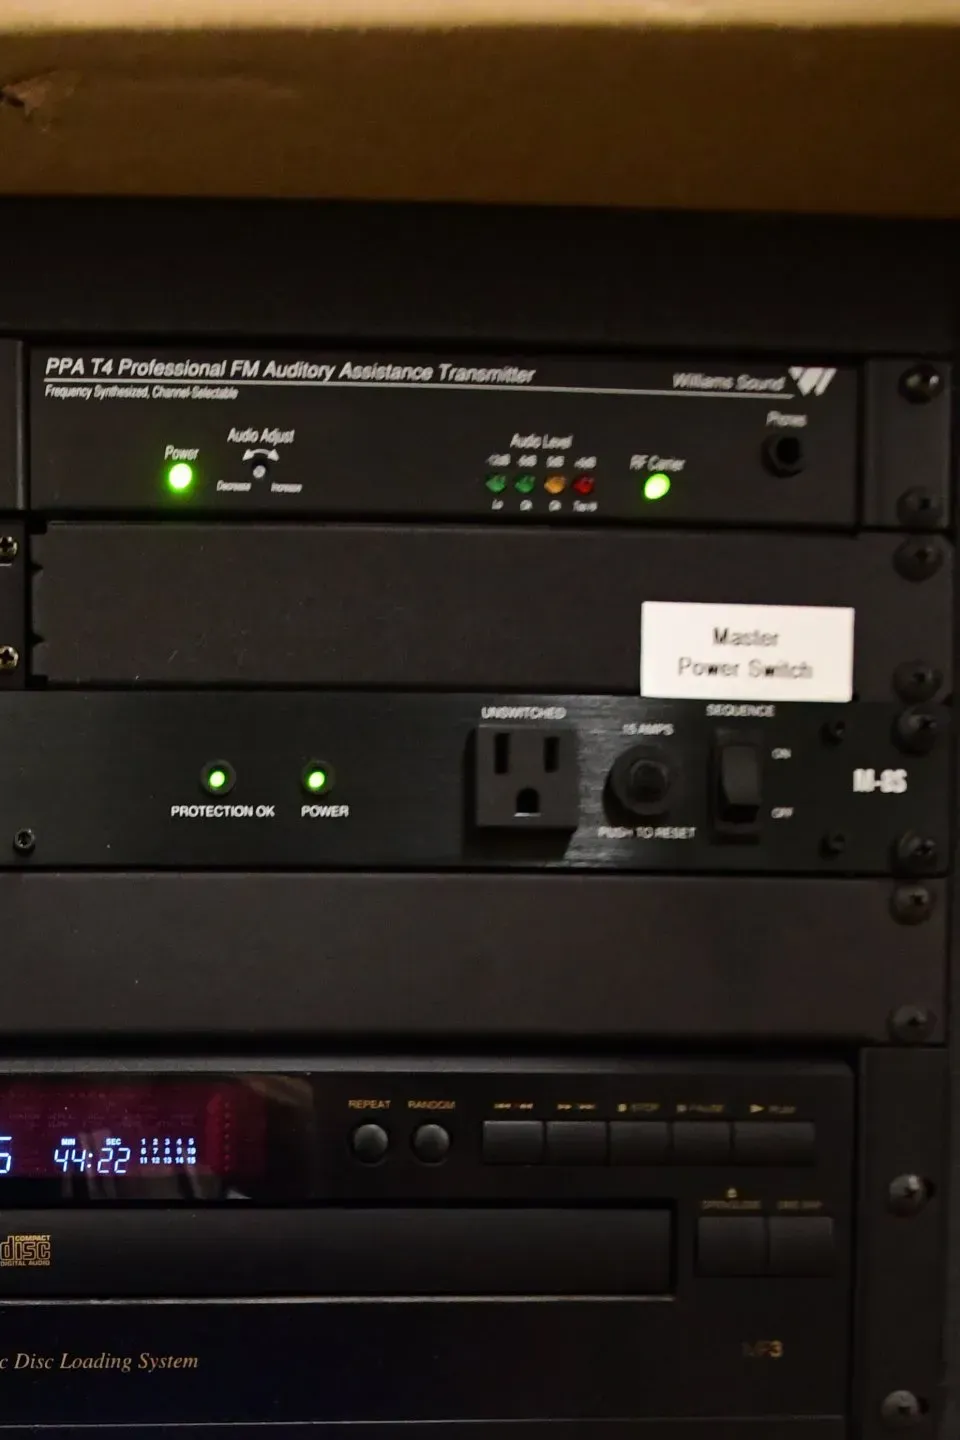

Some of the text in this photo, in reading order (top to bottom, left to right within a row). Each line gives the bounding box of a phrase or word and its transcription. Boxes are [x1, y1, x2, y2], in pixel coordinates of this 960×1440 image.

[45, 357, 536, 384] PPA T4 Professional FM Auditory Assistance Transmitter
[672, 373, 786, 391] Williams Sound
[44, 384, 93, 400] Frequency
[227, 428, 295, 446] Audio Adjust
[164, 445, 199, 460] Power
[712, 627, 779, 647] Master
[677, 656, 813, 679] Power Switch
[170, 804, 276, 818] PROTECTION OK
[300, 805, 350, 818] POWER
[348, 1099, 391, 1110] REPEAT
[407, 1099, 456, 1110] RANDOM
[60, 1138, 76, 1146] MIN
[105, 1138, 122, 1146] SEC
[54, 1147, 131, 1174] 44:22
[14, 1234, 51, 1242] COMPACT
[13, 1352, 54, 1370] Disc
[59, 1352, 132, 1374] Loading
[138, 1352, 199, 1373] System
